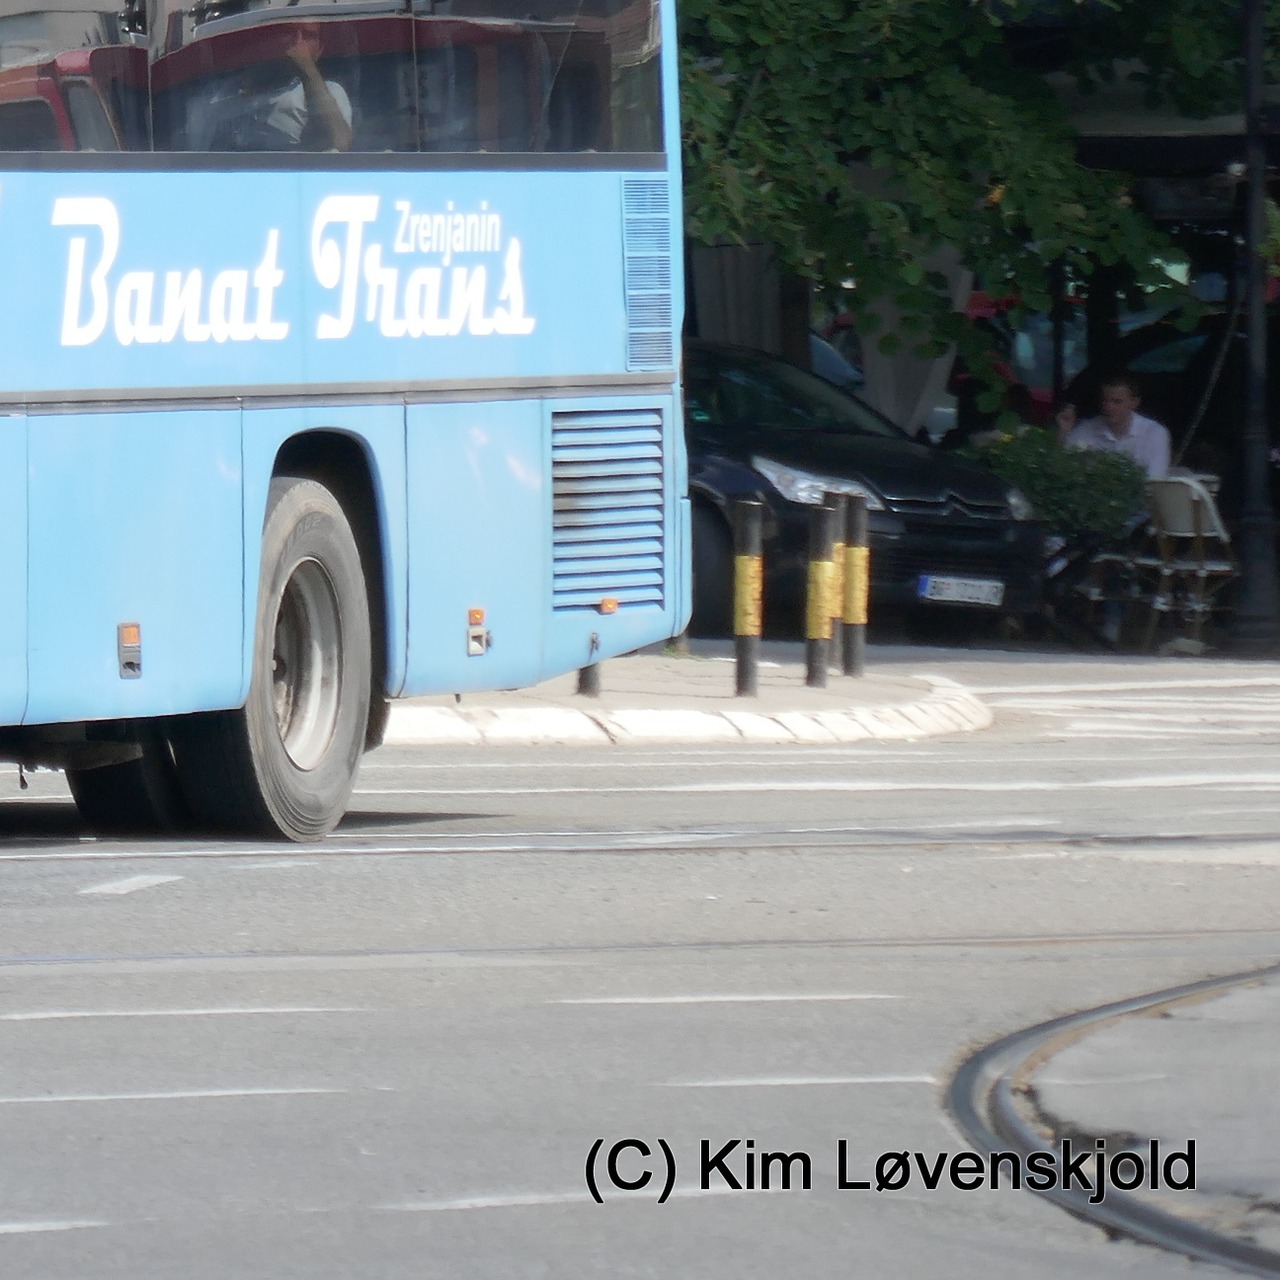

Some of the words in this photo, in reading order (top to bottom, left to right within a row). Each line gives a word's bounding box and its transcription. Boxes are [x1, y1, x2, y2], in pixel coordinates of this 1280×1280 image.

[51, 197, 289, 346] Banat
[311, 195, 535, 339] Trans
[394, 200, 501, 266] Zrenjanin
